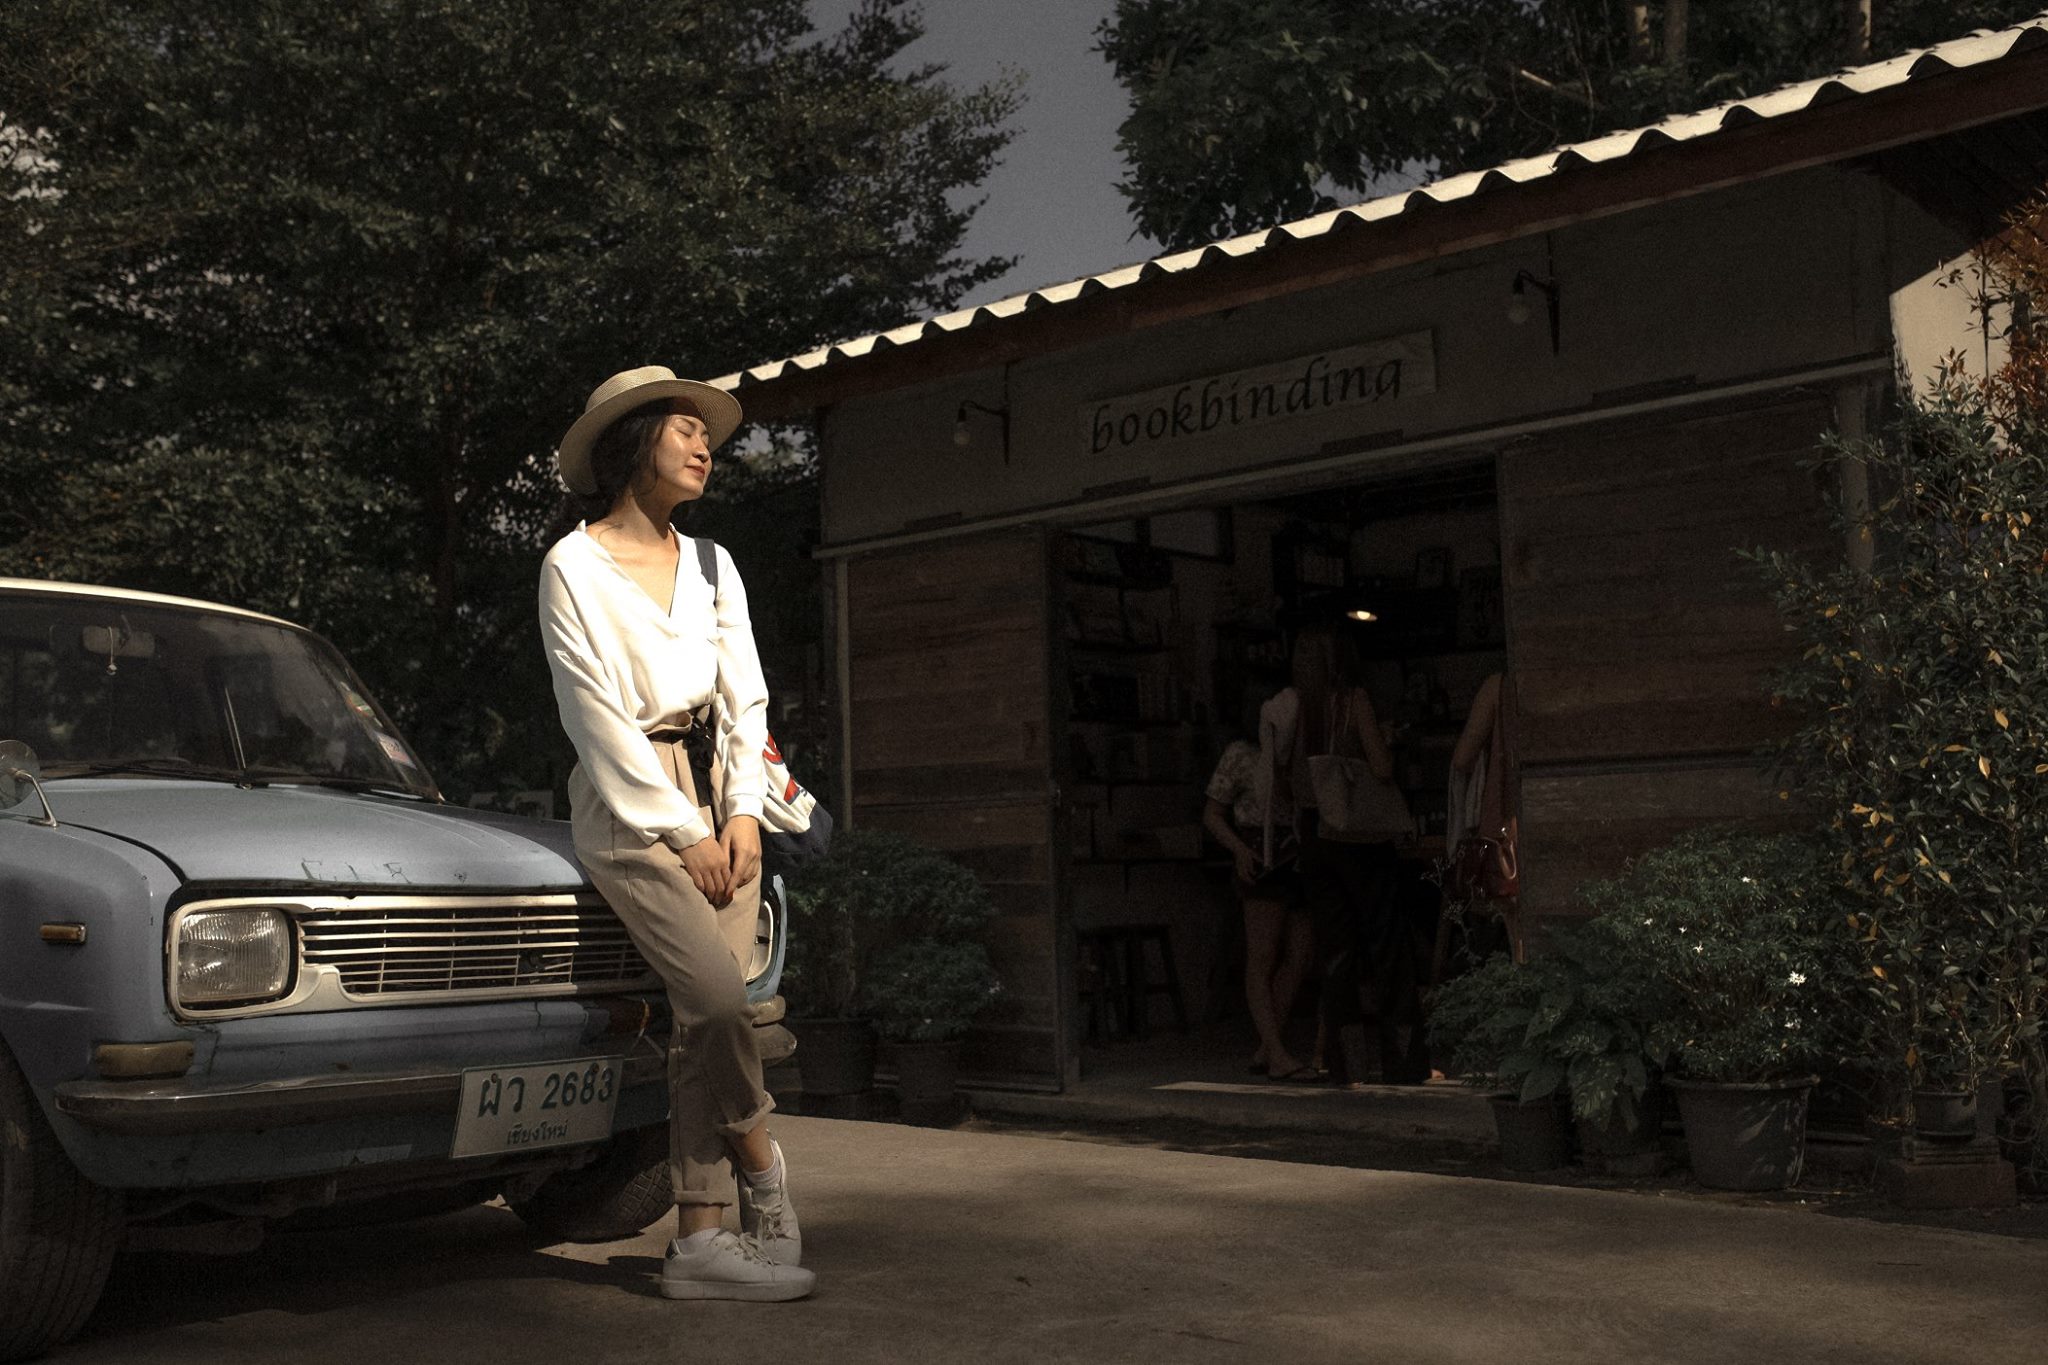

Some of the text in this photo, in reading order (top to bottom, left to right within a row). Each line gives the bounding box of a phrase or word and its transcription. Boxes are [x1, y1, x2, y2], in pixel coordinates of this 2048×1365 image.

[1092, 356, 1403, 453] bookbinding
[541, 1065, 614, 1109] 2683
[507, 1119, 568, 1145] เชียงใหม่
